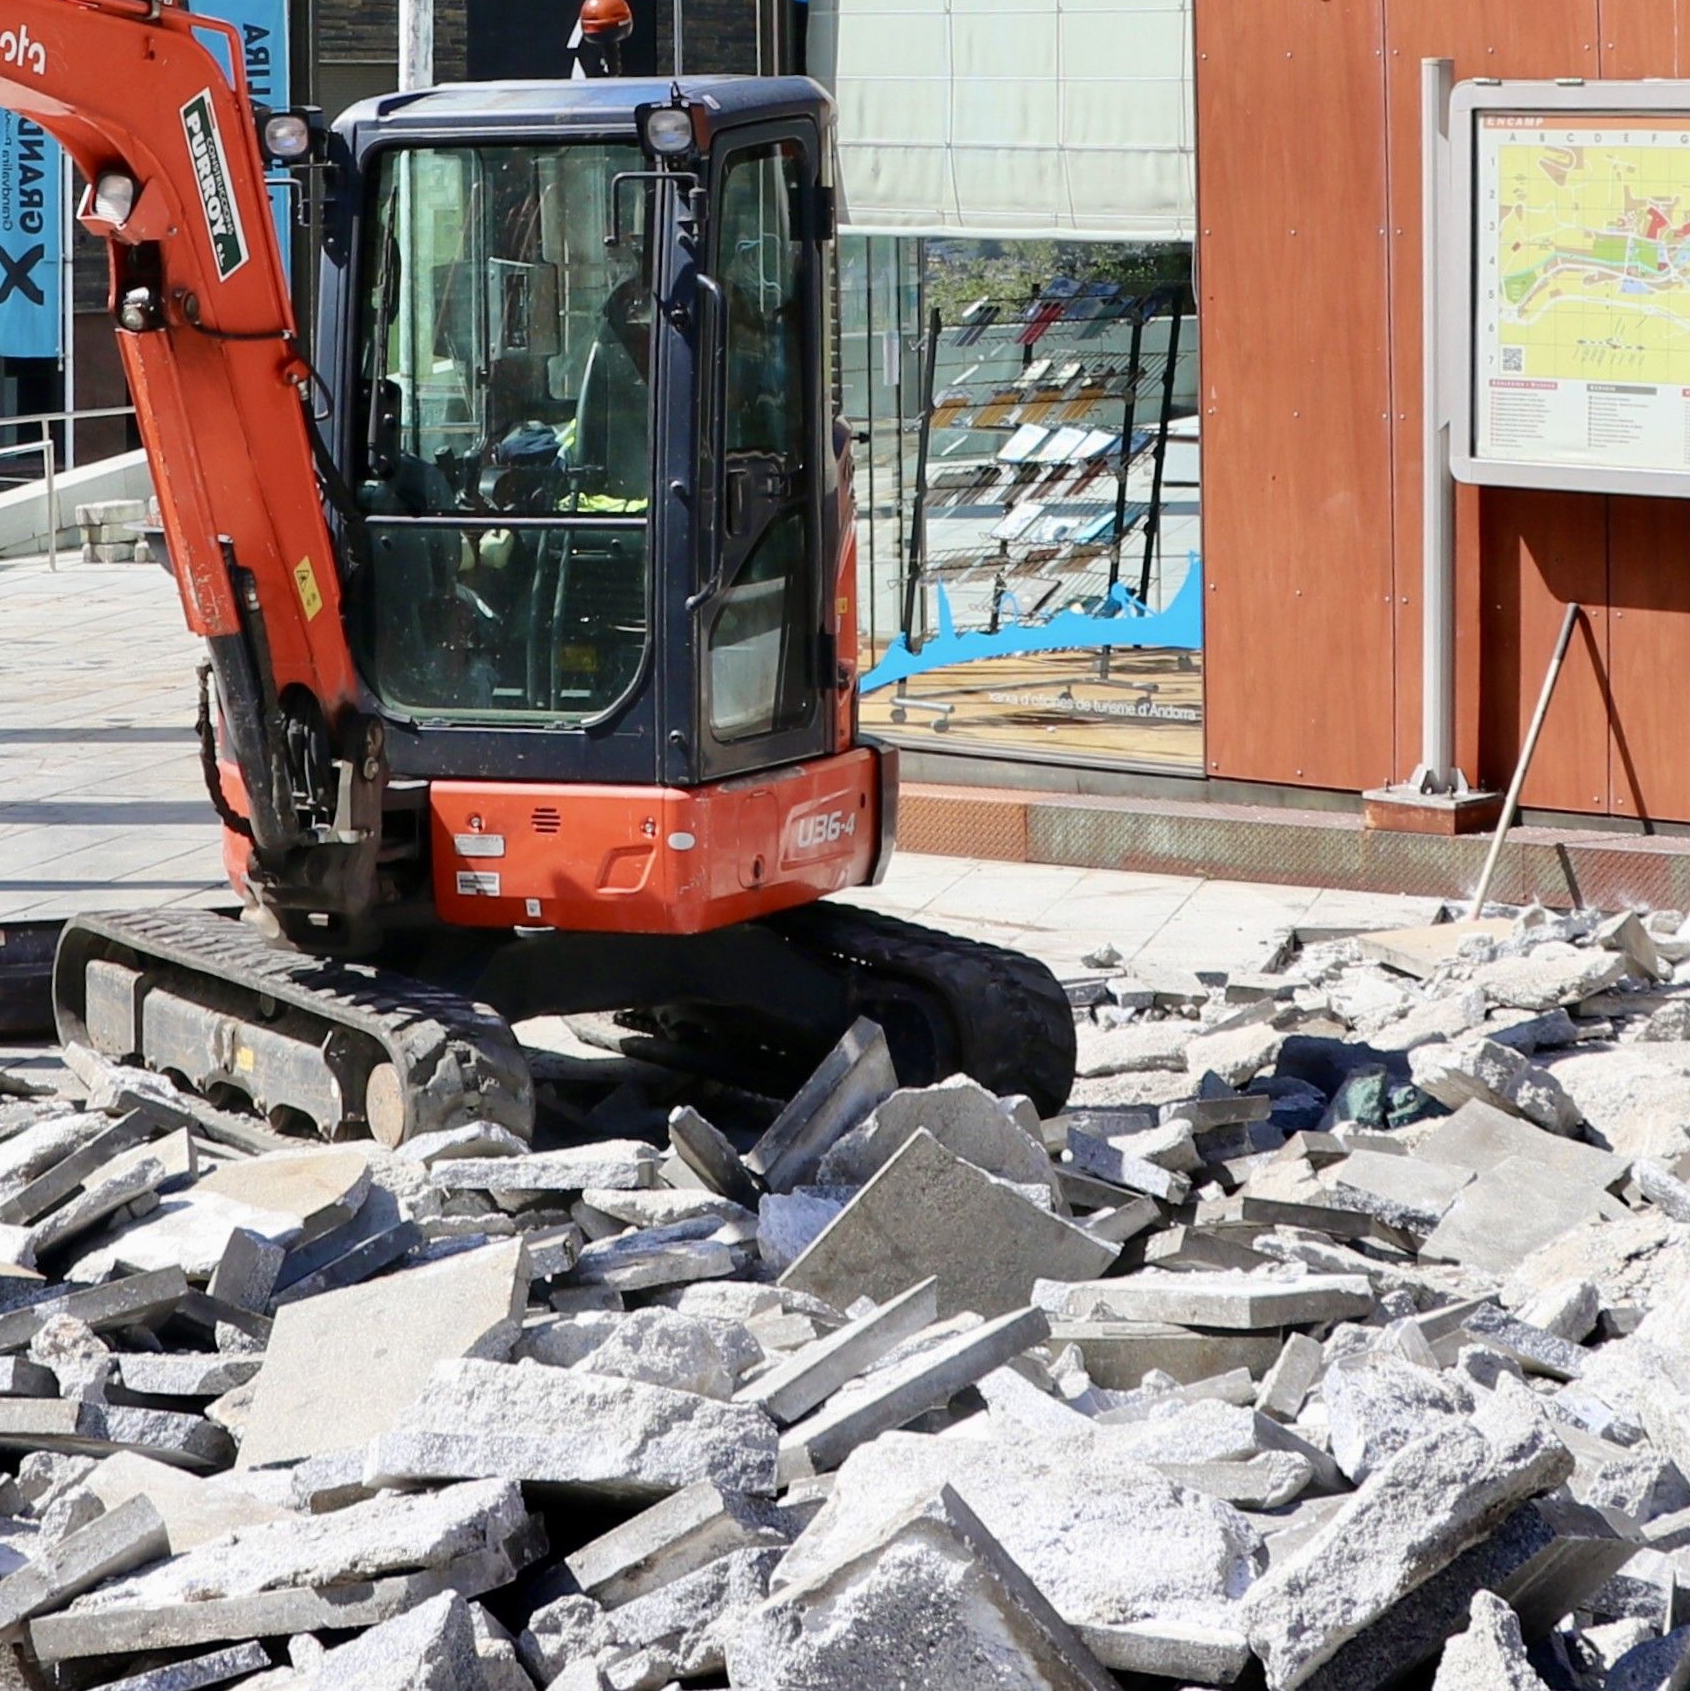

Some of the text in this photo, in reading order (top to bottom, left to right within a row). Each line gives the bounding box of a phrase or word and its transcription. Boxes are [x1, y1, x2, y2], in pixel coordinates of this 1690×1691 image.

[1487, 117, 1545, 126] ENCAMP
[1510, 133, 1516, 142] A
[1539, 133, 1545, 142] B
[1566, 133, 1574, 142] C
[1594, 133, 1602, 142] D
[1624, 133, 1629, 143] E
[1652, 133, 1657, 143] F
[1680, 134, 1689, 144] G
[185, 110, 227, 238] PURROY
[206, 135, 234, 236] CONSTRUCCIONS
[1094, 699, 1136, 715] turisme
[1138, 702, 1196, 721] d'Andorra
[796, 810, 856, 848] U36-4
